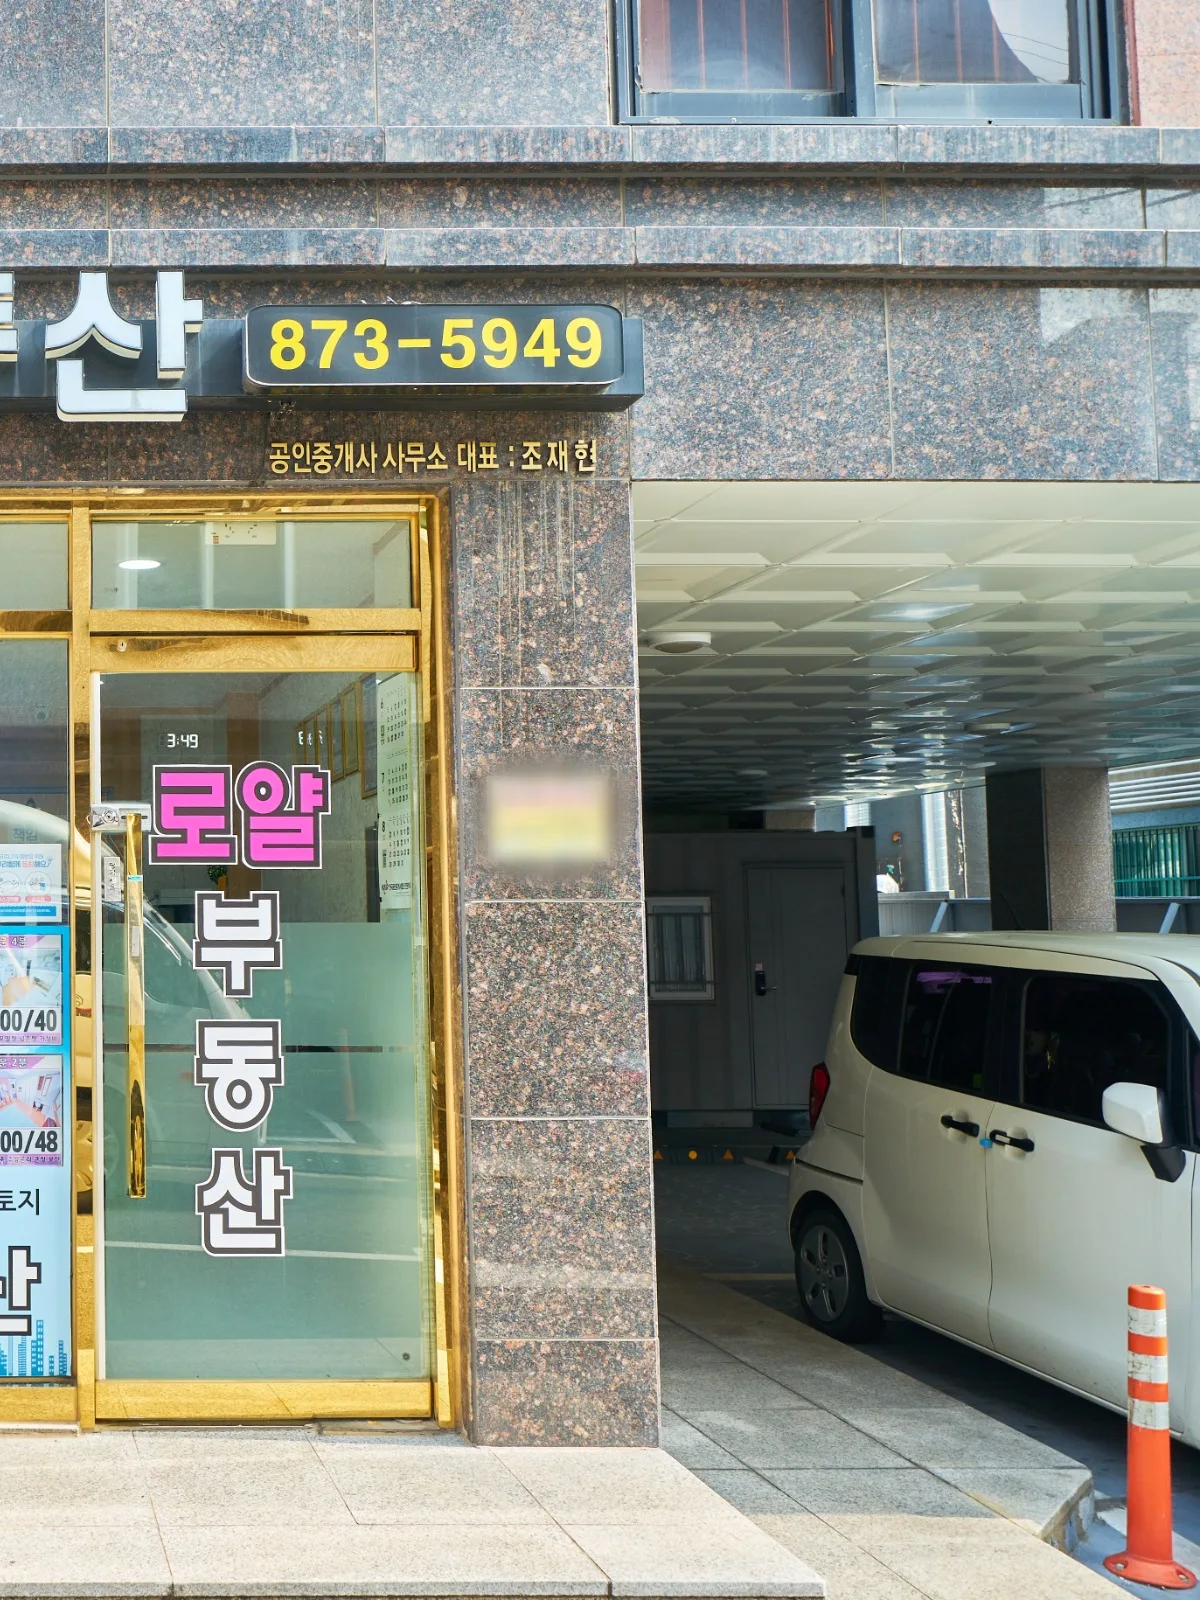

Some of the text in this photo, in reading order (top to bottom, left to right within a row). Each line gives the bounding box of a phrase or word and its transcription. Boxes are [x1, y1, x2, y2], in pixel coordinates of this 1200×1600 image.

[269, 316, 603, 370] 873-5949
[269, 441, 378, 474] 공인중개사
[382, 440, 449, 473] 사무소
[457, 439, 500, 472] 대표
[167, 733, 199, 748] 3:49
[149, 760, 331, 869] 로얄
[11, 937, 27, 948] 4분
[11, 1058, 27, 1068] 2분
[193, 891, 293, 1257] 부동산
